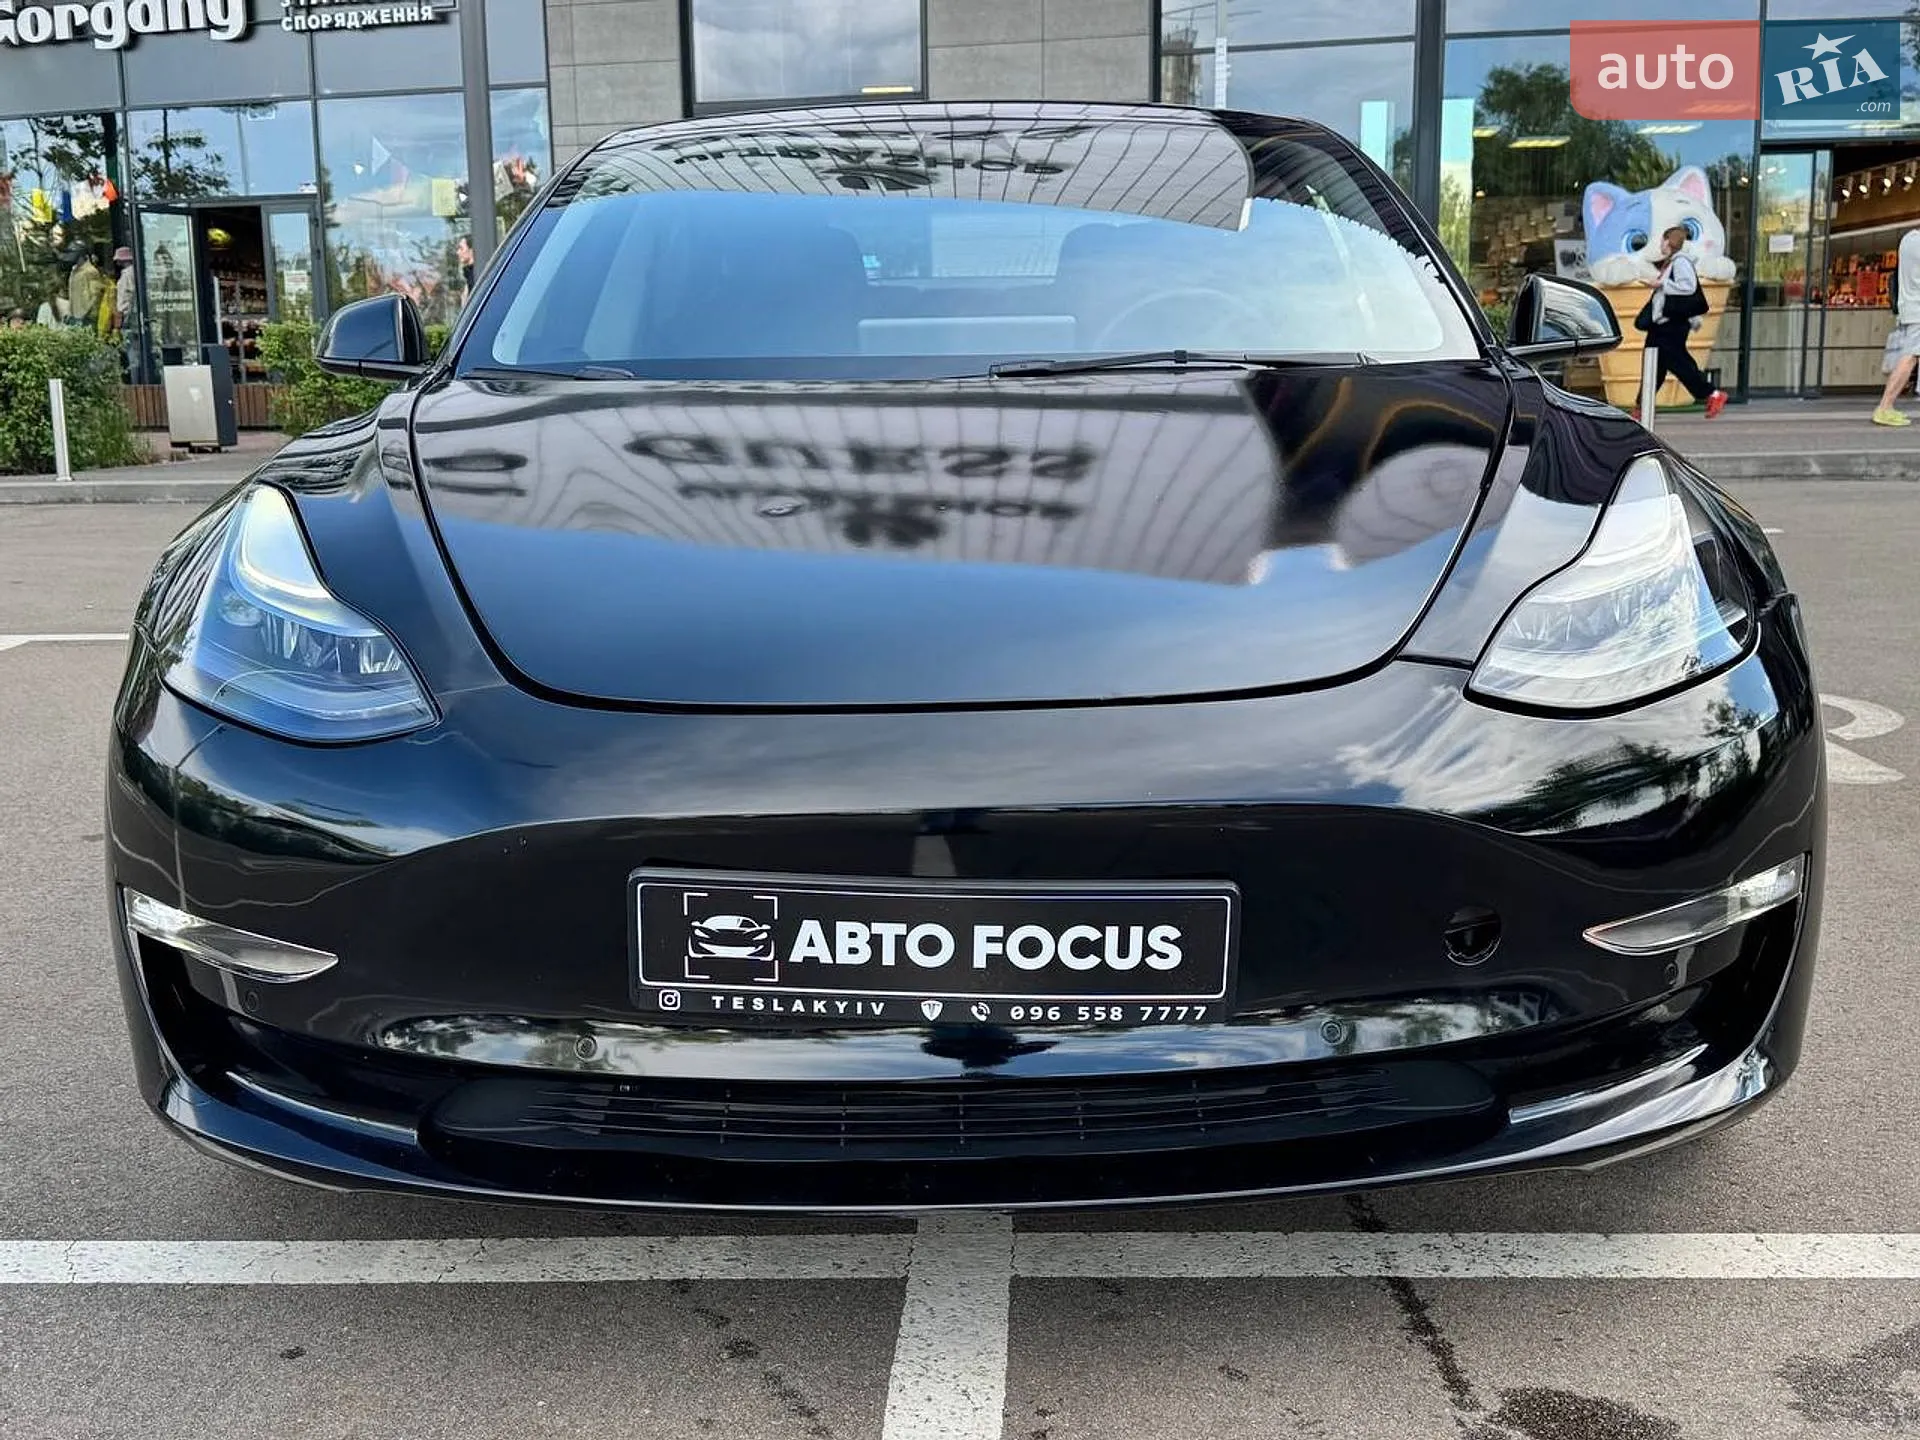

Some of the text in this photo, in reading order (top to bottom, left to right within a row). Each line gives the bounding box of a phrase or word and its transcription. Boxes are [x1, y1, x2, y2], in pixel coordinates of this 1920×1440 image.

[281, 5, 433, 32] СПОРЯДЖЕННЯ
[972, 924, 1183, 971] FOCUS
[711, 995, 885, 1016] TESLAKYIV
[1010, 1005, 1208, 1021] 096 558 7777
